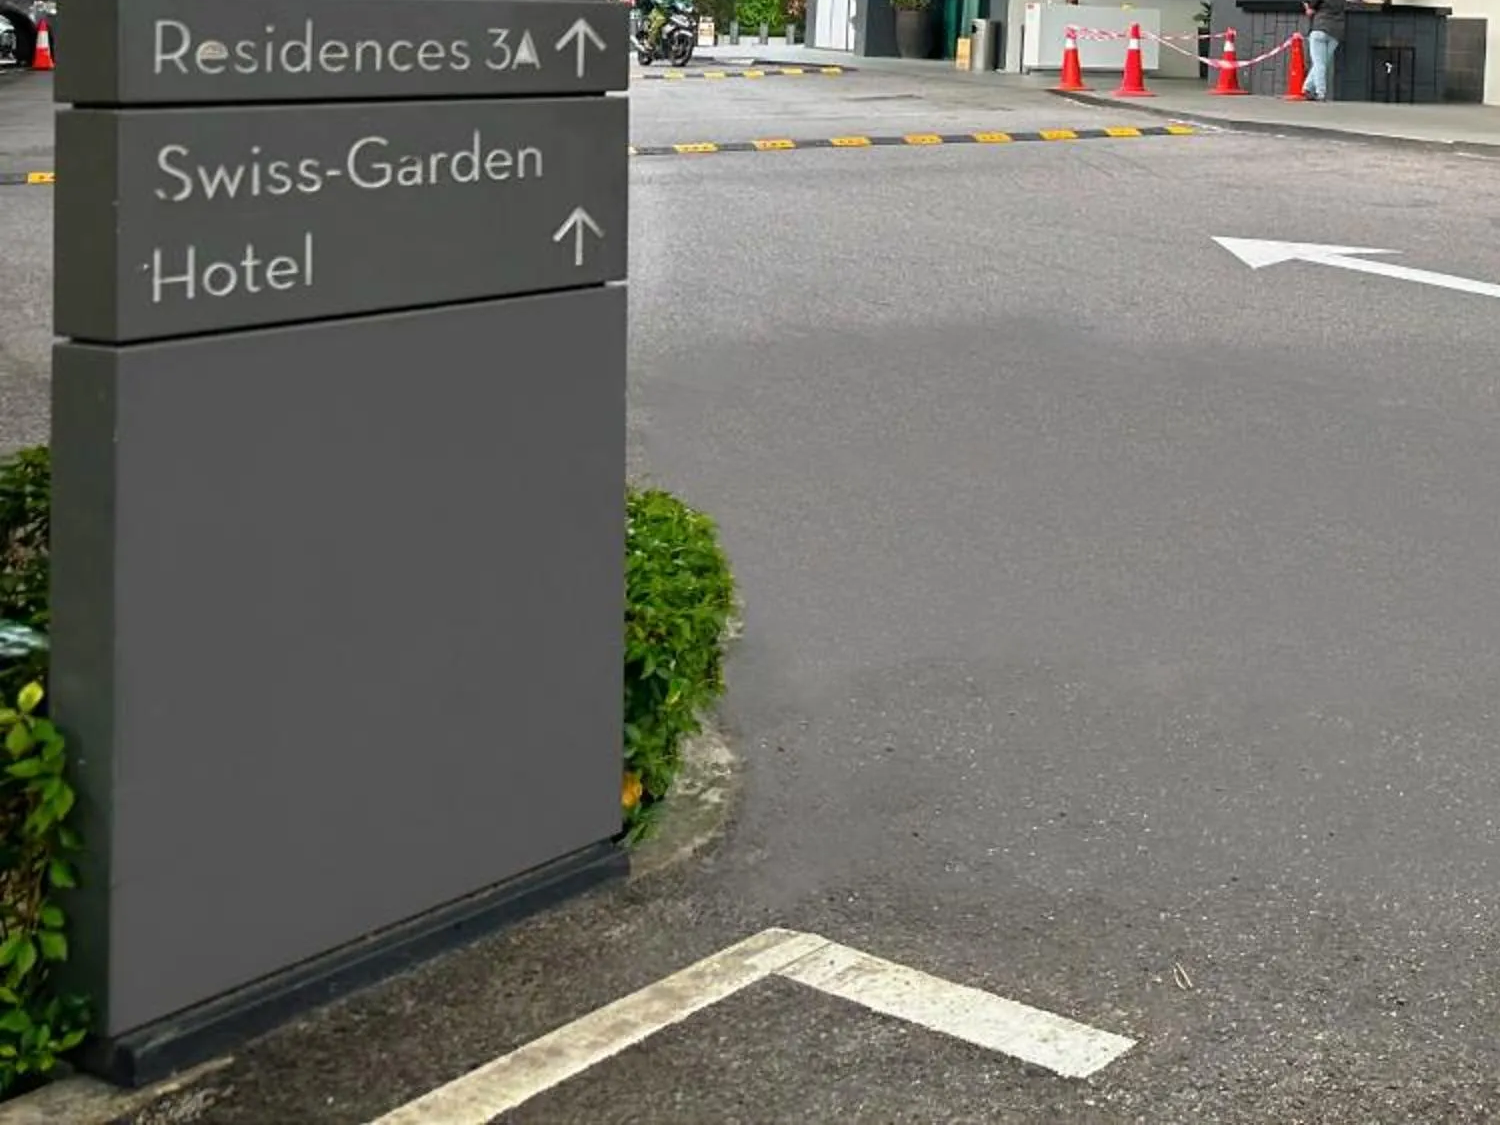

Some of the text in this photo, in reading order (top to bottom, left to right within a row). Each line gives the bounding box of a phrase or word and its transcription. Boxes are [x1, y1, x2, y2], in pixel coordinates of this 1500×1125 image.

[153, 19, 541, 75] Residences 3A
[155, 129, 544, 203] Swiss-Garden
[152, 231, 314, 304] Hotel
